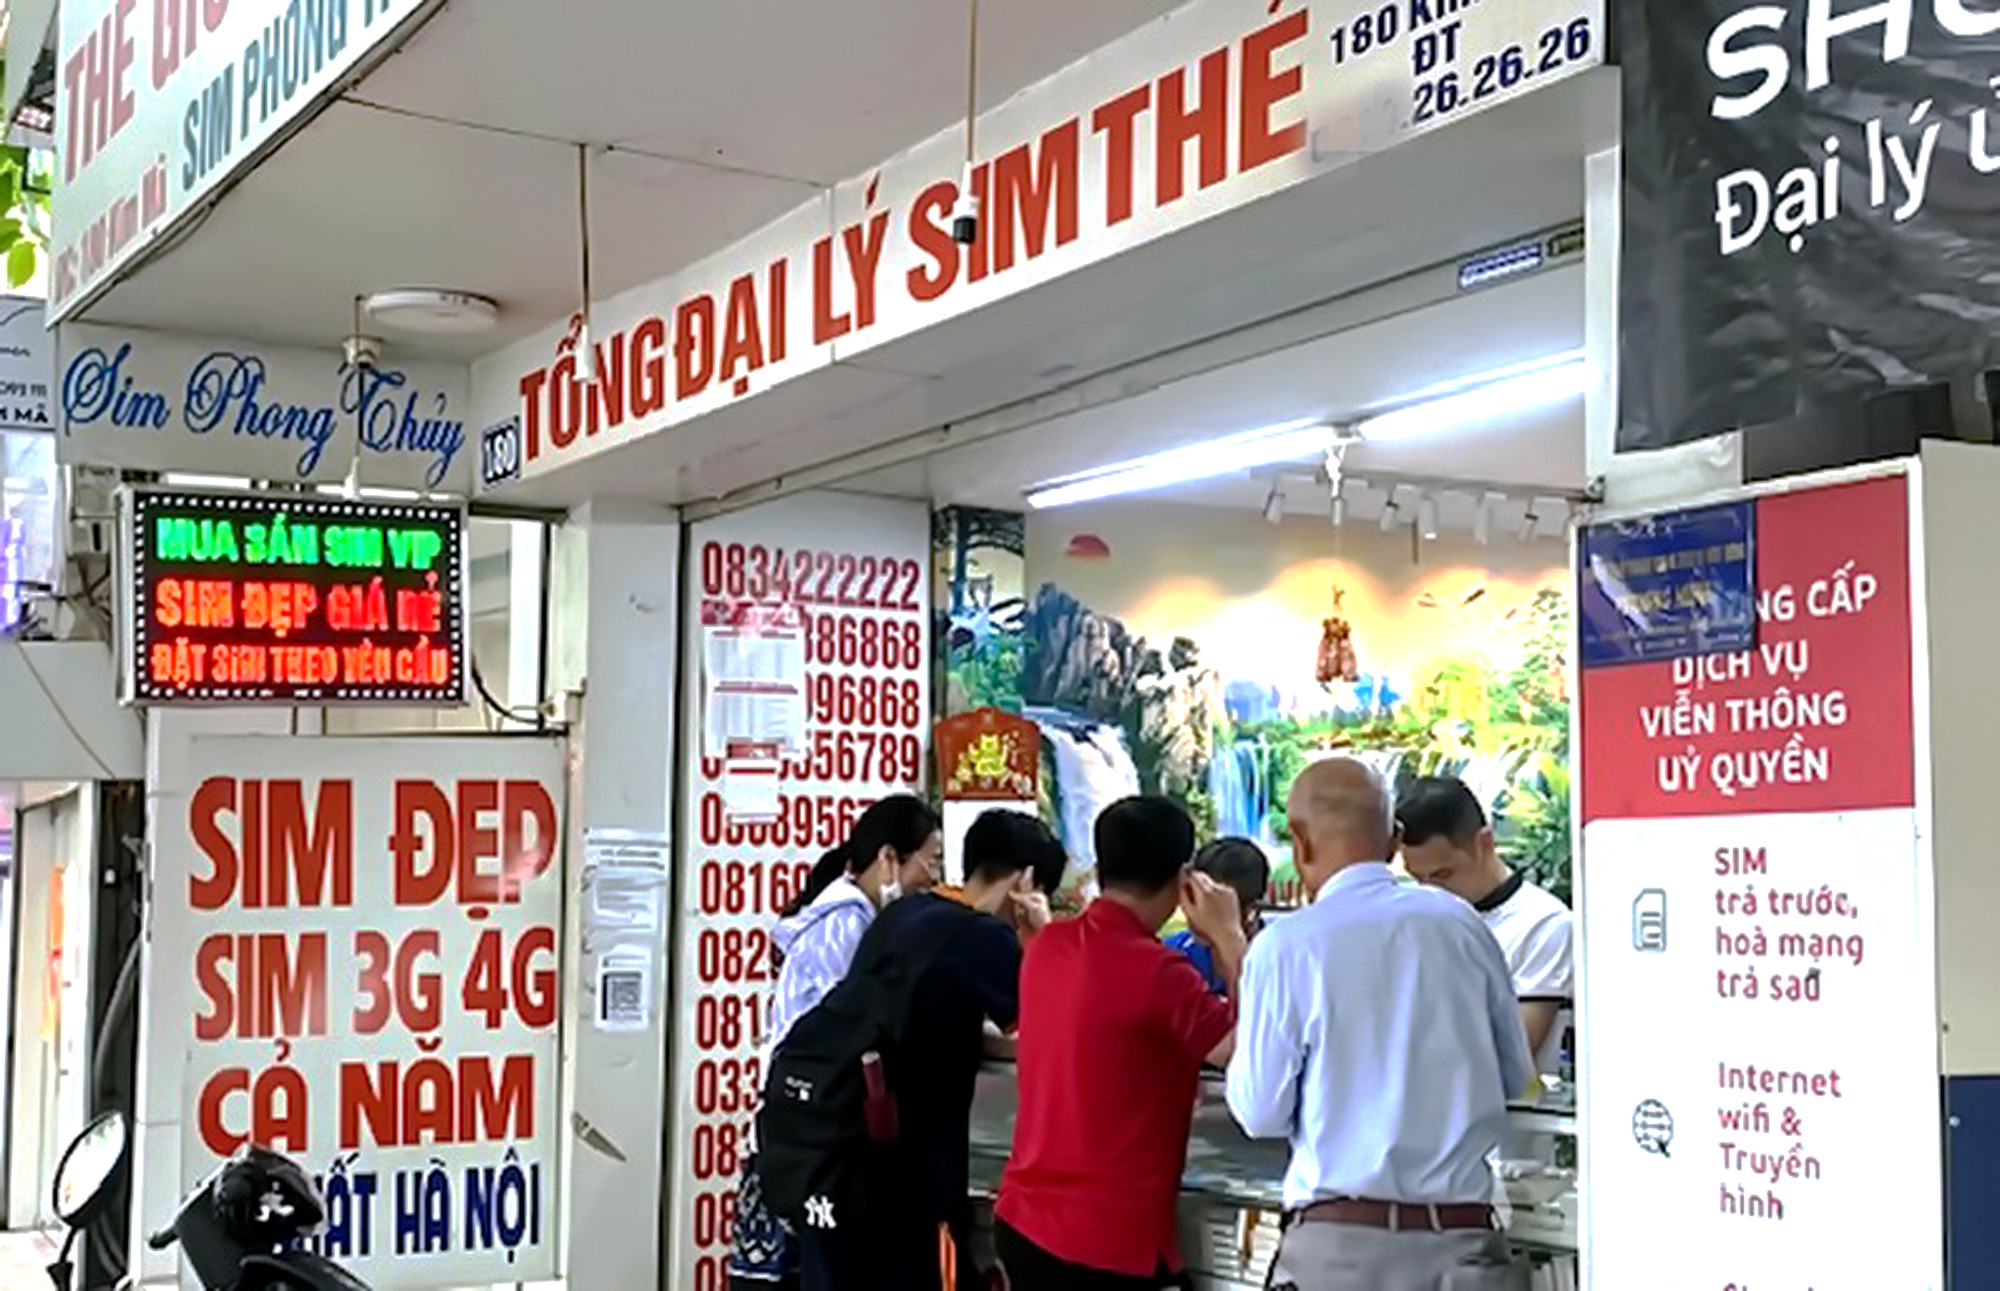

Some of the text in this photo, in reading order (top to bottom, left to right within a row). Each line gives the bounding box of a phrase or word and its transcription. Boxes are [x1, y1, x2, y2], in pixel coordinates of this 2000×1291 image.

[1330, 4, 1398, 64] 180
[1411, 21, 1461, 76] ĐT
[1412, 17, 1590, 125] 26.26.26
[182, 62, 234, 191] SIM
[1715, 135, 1840, 256] Đại
[1866, 98, 1942, 222] lý
[520, 312, 664, 462] TỔNG
[674, 258, 787, 398] ĐẠI
[813, 170, 890, 346] LÝ
[907, 116, 1080, 302] SIM
[62, 342, 465, 488] Sim Phong Thủy
[156, 517, 238, 562] MUA
[324, 525, 384, 568] SIM
[387, 529, 442, 570] VIP
[701, 540, 922, 613] 0834222222
[1807, 559, 1877, 618] CẤP
[155, 578, 234, 628] SIM
[241, 581, 318, 637] ĐẸP
[327, 575, 389, 632] GIÁ
[1673, 641, 1808, 690] DỊCH VỤ
[1640, 686, 1847, 738] VIỄN THÔNG
[1658, 731, 1828, 797] UỶ QUYỀN
[189, 776, 353, 910] SIM
[388, 779, 558, 920] ĐẸP
[1714, 846, 1767, 876] SIM
[1714, 883, 1858, 919] trả trước,
[699, 927, 780, 983] 082
[1715, 924, 1864, 967] hoà mạng
[194, 926, 557, 1042] SIM 3G 4G
[1716, 964, 1759, 999] trả
[695, 994, 774, 1050] 081
[199, 1037, 534, 1158] CẢ NĂM
[1718, 1060, 1842, 1099] Internet
[1717, 1101, 1802, 1137] wifi &
[1718, 1141, 1821, 1184] Truyền
[395, 1158, 452, 1256] HÀ
[464, 1147, 539, 1264] NỘI
[1719, 1181, 1784, 1221] hình
